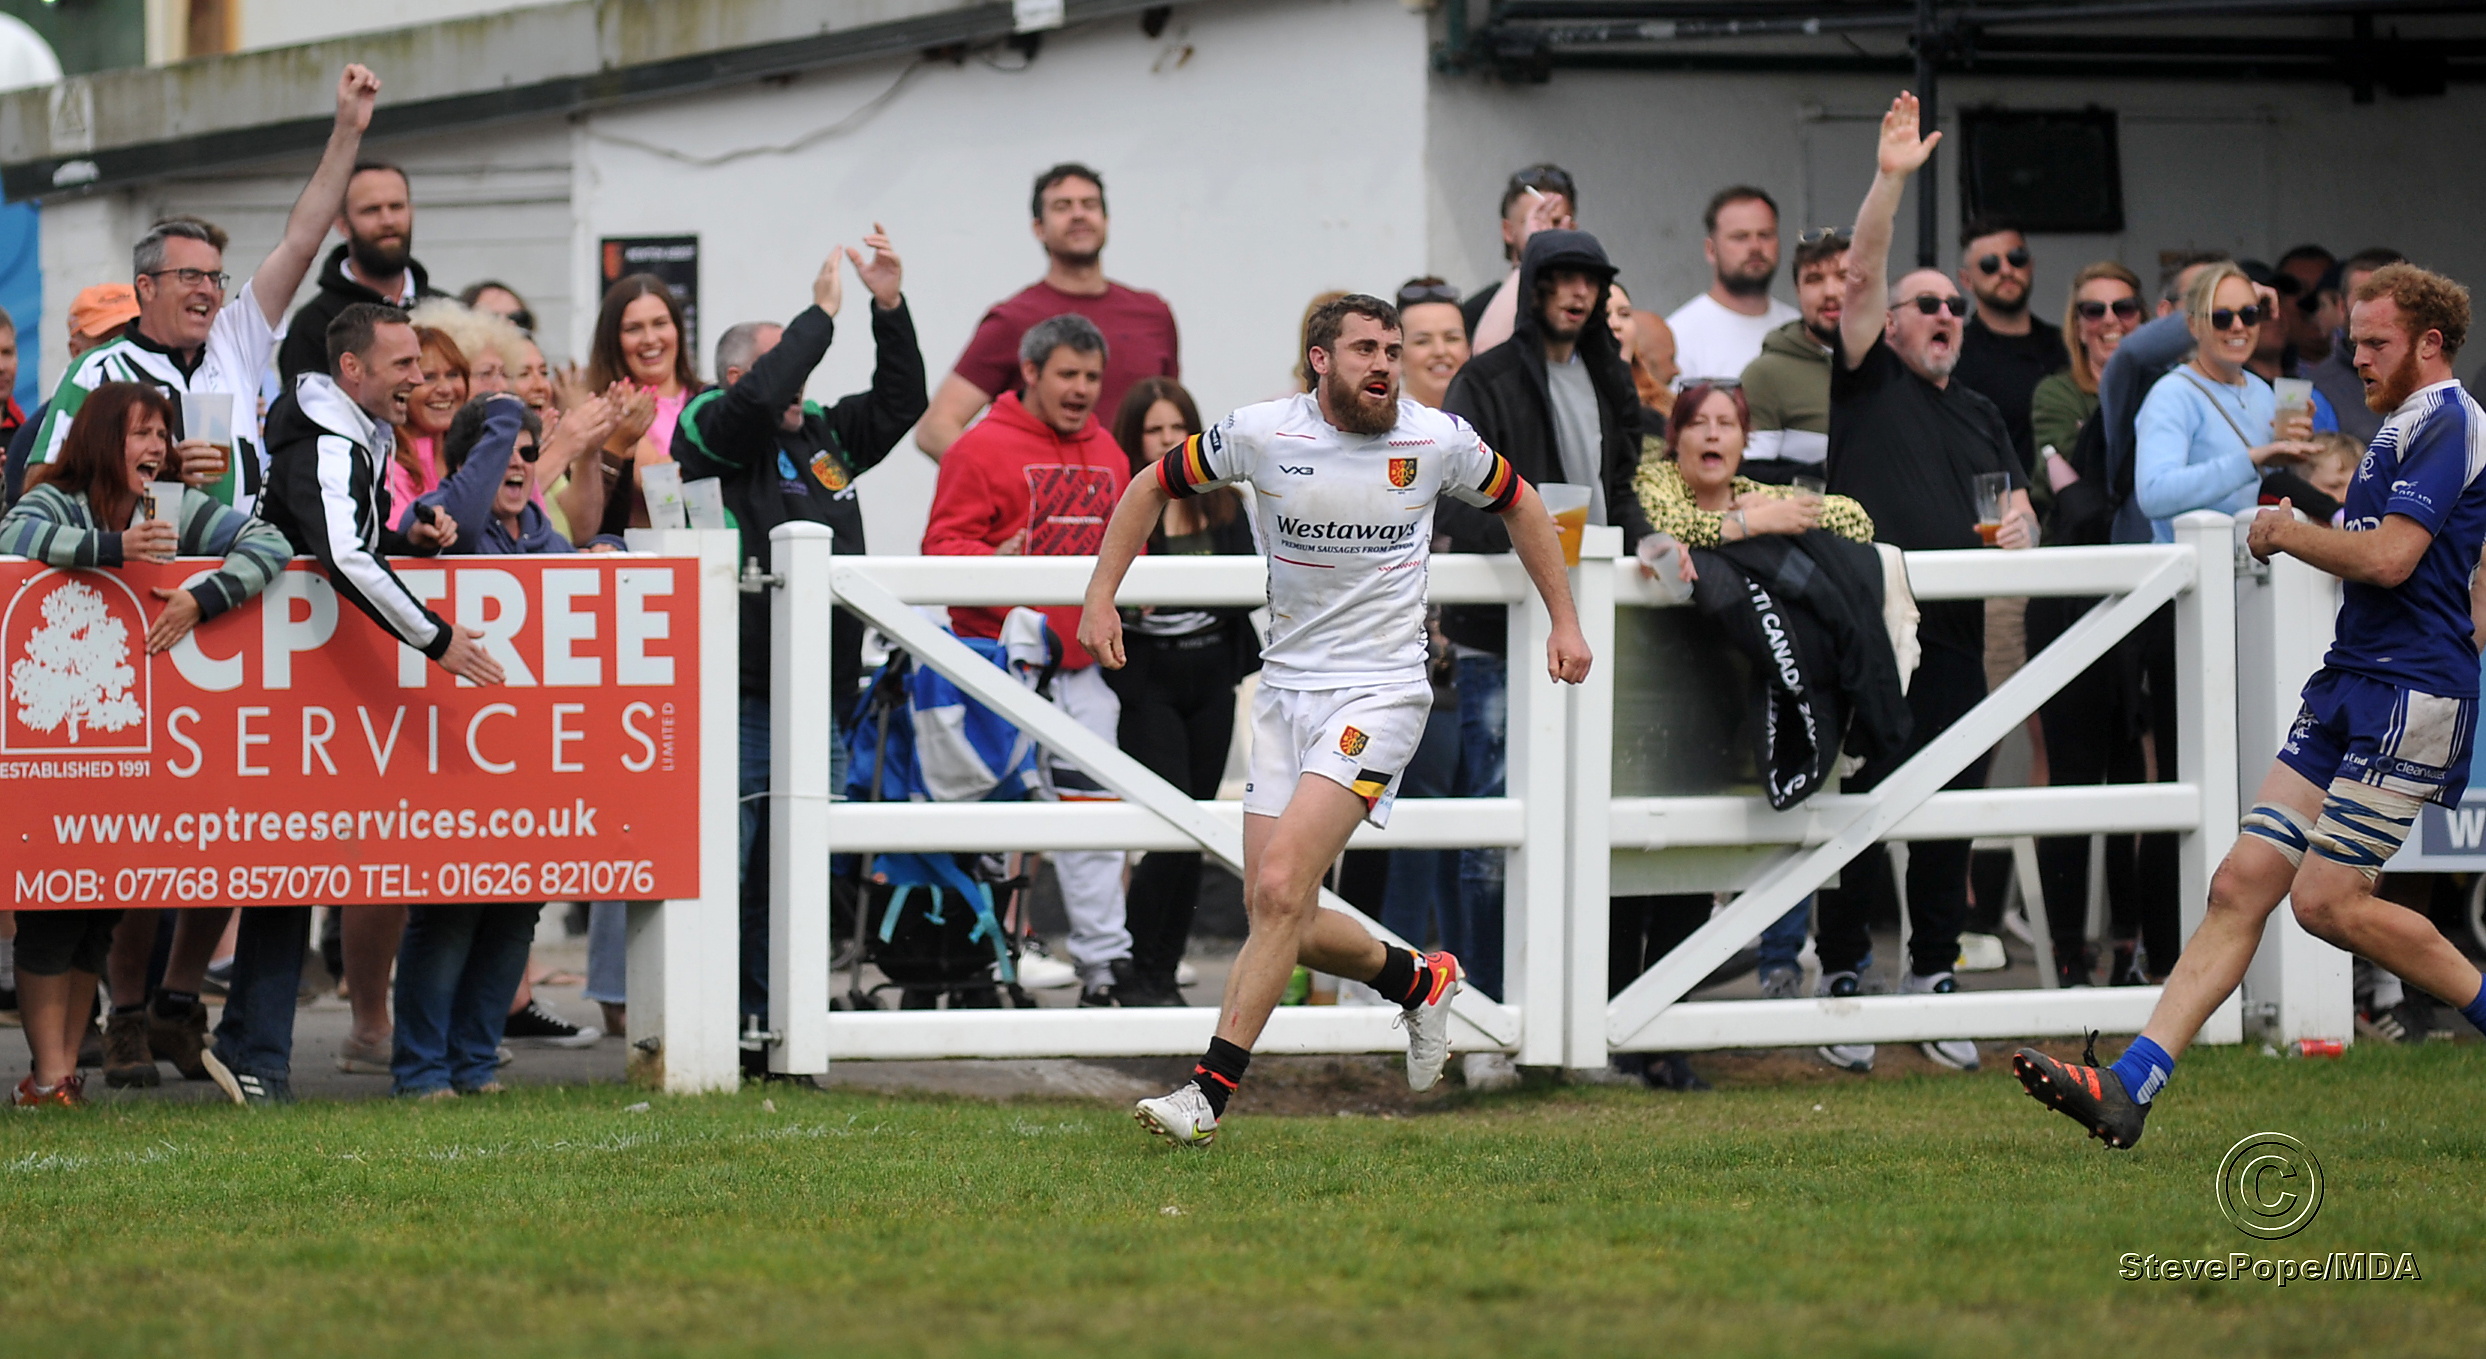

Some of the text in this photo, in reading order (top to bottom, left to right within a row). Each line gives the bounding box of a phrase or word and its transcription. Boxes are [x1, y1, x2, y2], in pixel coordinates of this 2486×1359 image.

[1276, 514, 1418, 545] Westaways
[1281, 539, 1315, 553] PREMIUM
[1316, 545, 1360, 554] SAUSAGES
[1361, 545, 1388, 553] FROM
[393, 567, 676, 688] TREE
[166, 701, 658, 778] SERVICES
[661, 702, 676, 772] LIMITED
[0, 760, 150, 779] ESTABLISHED 1991
[53, 798, 598, 850] www.cptreeservices.co.uk
[15, 860, 654, 903] MOB: 07768 857070 TEL: 01626 821076
